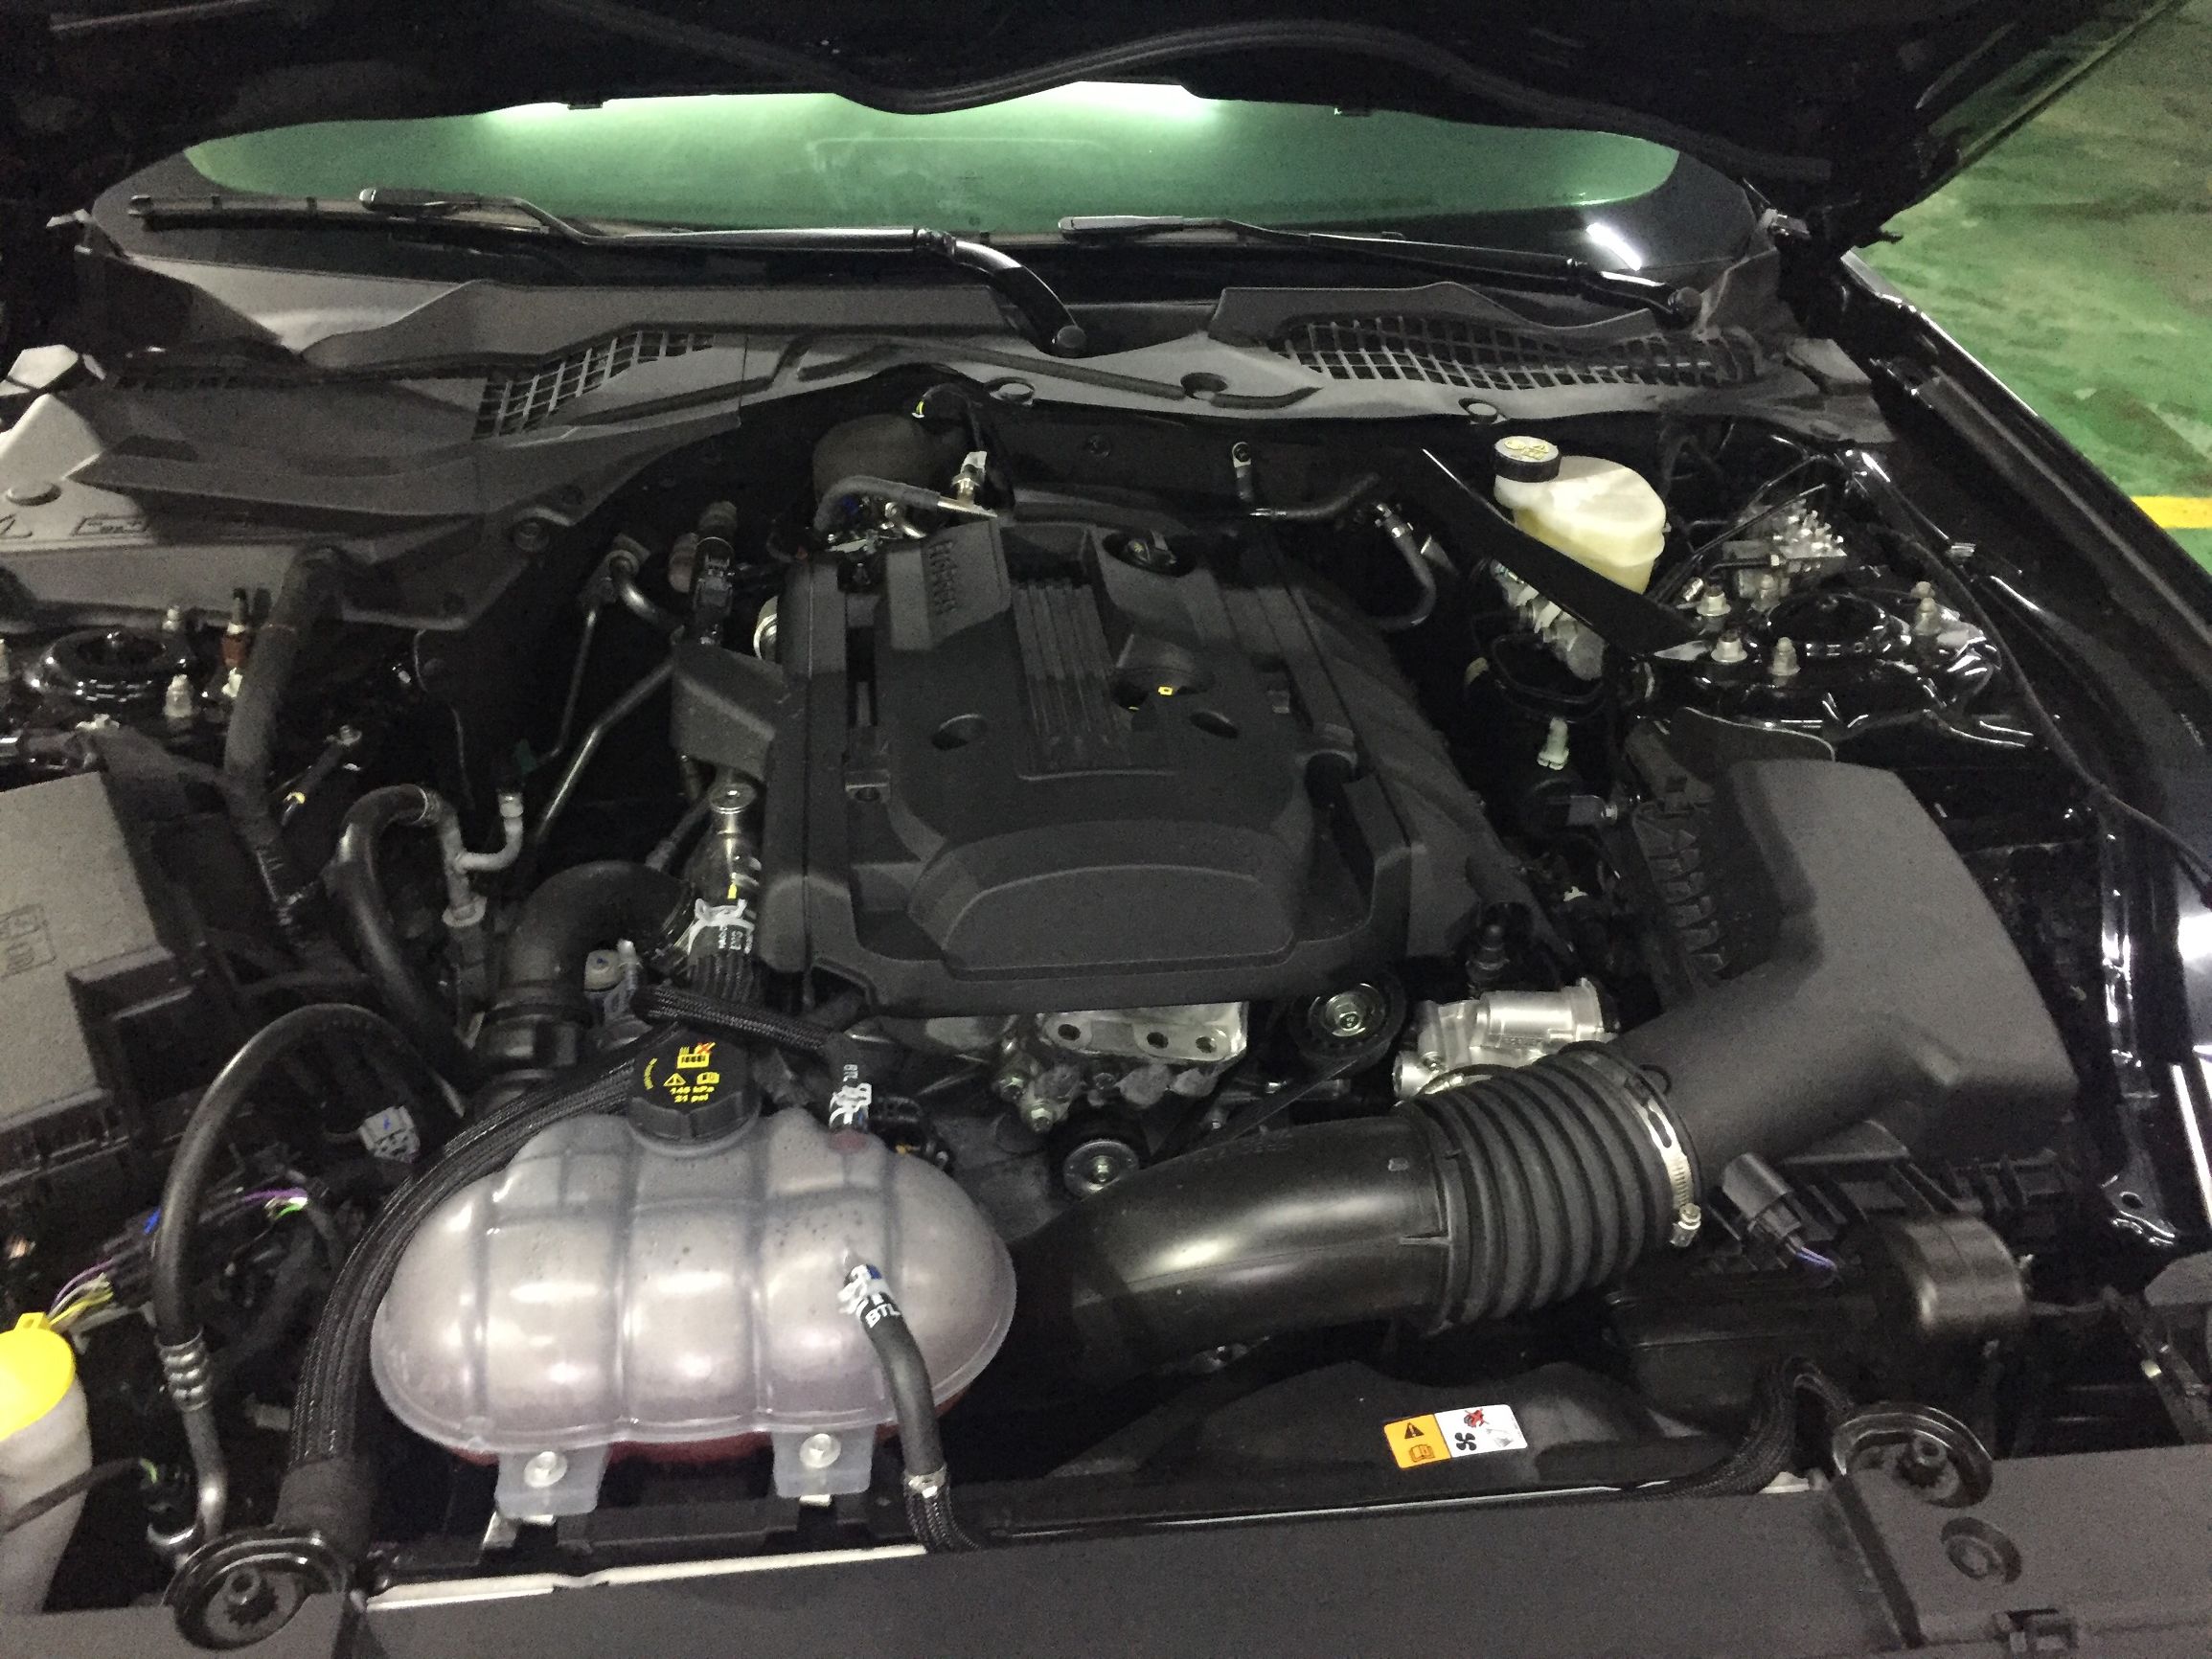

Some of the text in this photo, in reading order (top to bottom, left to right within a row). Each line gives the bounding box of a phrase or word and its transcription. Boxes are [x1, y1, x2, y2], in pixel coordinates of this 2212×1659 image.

[674, 1093, 709, 1103] 21 psi
[865, 1303, 901, 1329] BTL
